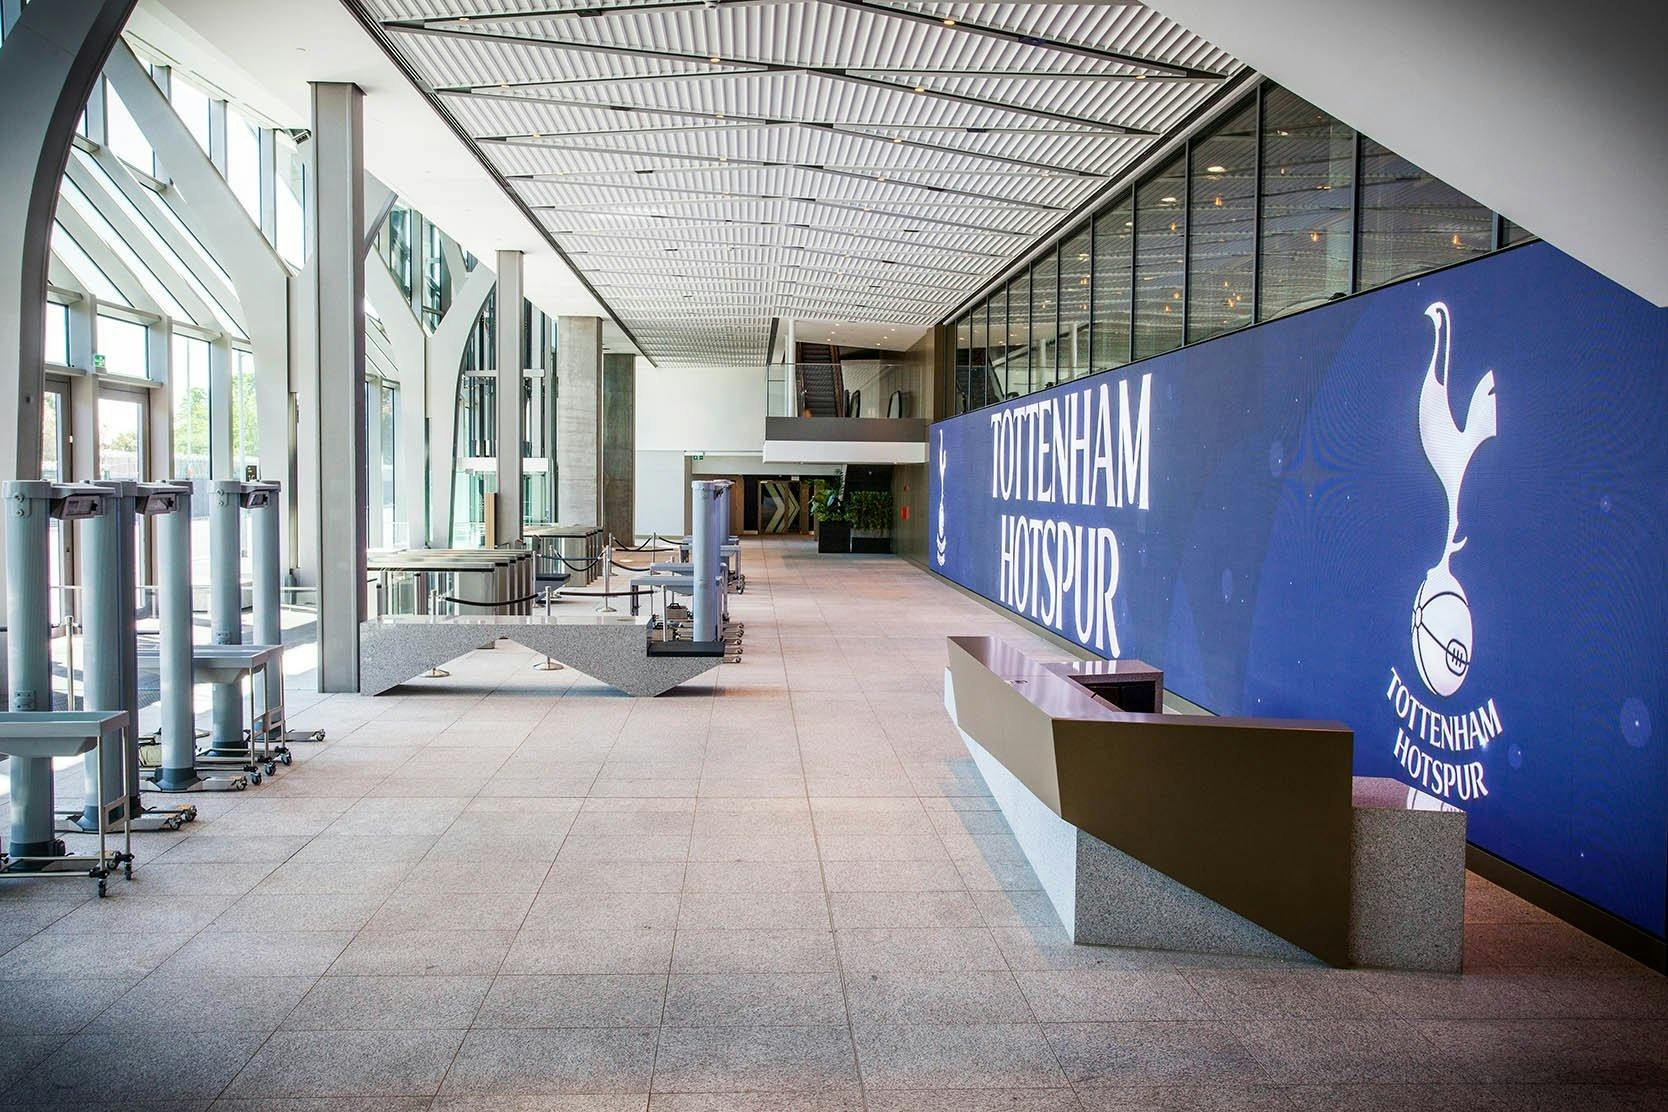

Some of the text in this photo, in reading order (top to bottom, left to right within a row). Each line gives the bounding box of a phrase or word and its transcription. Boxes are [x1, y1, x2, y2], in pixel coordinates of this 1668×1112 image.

[991, 373, 1152, 510] TOTTENHAM
[1000, 515, 1120, 658] HOTSPUR
[1386, 667, 1503, 751] TOTTENHAM
[1393, 728, 1488, 800] HOTSPUR
